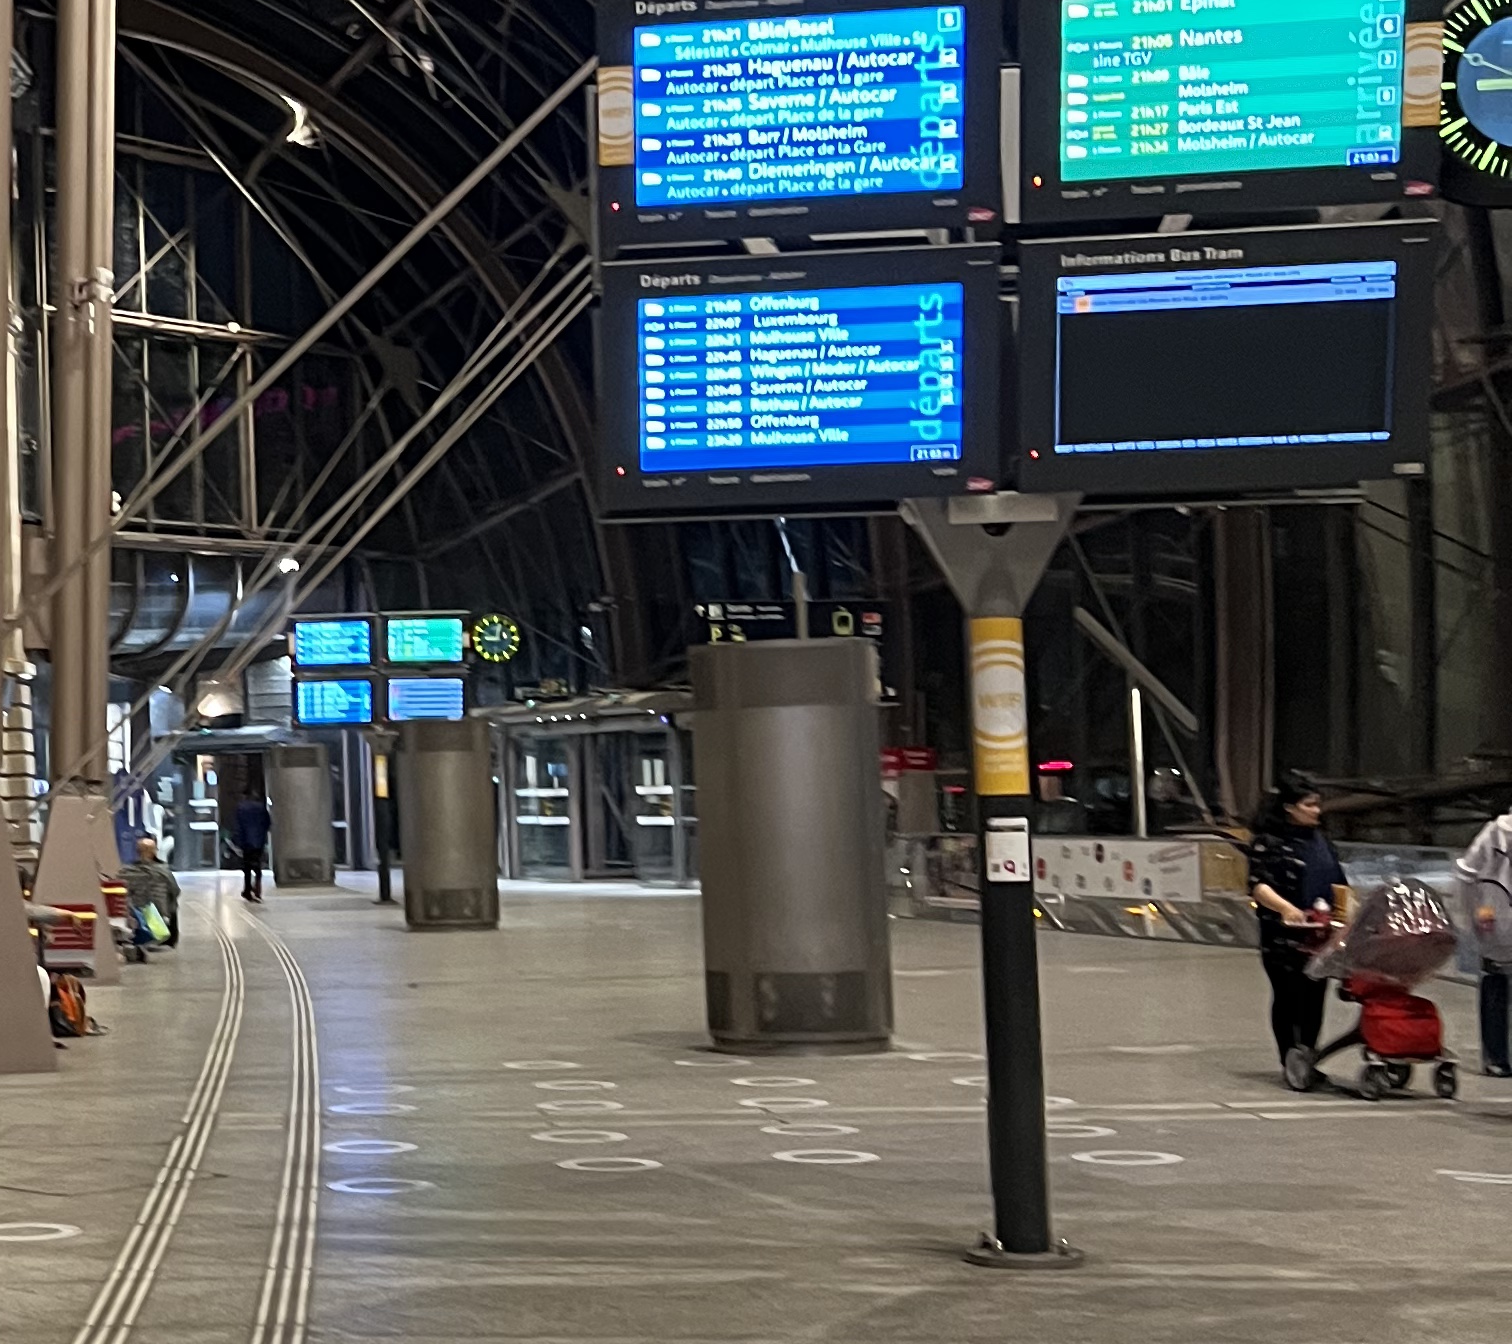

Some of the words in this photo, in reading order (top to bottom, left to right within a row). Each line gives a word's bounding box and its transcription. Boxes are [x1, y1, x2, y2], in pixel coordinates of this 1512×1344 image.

[635, 0, 697, 15] Départs
[1179, 28, 1243, 47] Nantes
[740, 41, 790, 56] Colmar
[748, 57, 833, 77] Haguenau
[847, 51, 915, 69] Autocar
[1123, 50, 1152, 66] TGV
[666, 81, 719, 95] Autocar
[730, 77, 775, 93] départ
[778, 75, 814, 88] Place
[818, 72, 835, 86] de
[838, 71, 851, 85] la
[854, 71, 884, 87] gare
[829, 87, 897, 105] Autocar
[666, 116, 719, 130] Autocar
[730, 112, 775, 128] départ
[778, 110, 814, 123] Place
[818, 107, 835, 121] de
[838, 106, 851, 120] la
[854, 106, 884, 122] gare
[1177, 118, 1244, 135] Bordeaux
[1248, 115, 1263, 130] St
[1266, 114, 1301, 128] Jean
[748, 128, 780, 145] Barr
[792, 124, 868, 142] Molsheim
[1257, 131, 1315, 146] Autocar
[666, 151, 719, 165] Autocar
[730, 147, 775, 163] départ
[778, 145, 814, 158] Place
[818, 142, 835, 156] de
[838, 141, 851, 155] la
[854, 141, 886, 157] Gare
[870, 155, 937, 172] Autocar
[666, 185, 719, 199] Autocar
[730, 181, 775, 197] départ
[778, 179, 814, 192] Place
[818, 176, 835, 190] de
[838, 175, 851, 189] la
[854, 175, 883, 191] gare
[1061, 249, 1165, 268] Informations
[1170, 247, 1200, 263] Bus
[640, 273, 701, 289] Départs
[749, 296, 819, 311] Offenburg
[753, 312, 838, 328] Luxembourg
[828, 344, 881, 358] Autocar
[866, 359, 920, 373] Autocar
[909, 292, 943, 441] départs
[814, 378, 868, 392] Autocar
[809, 395, 863, 409] Autocar
